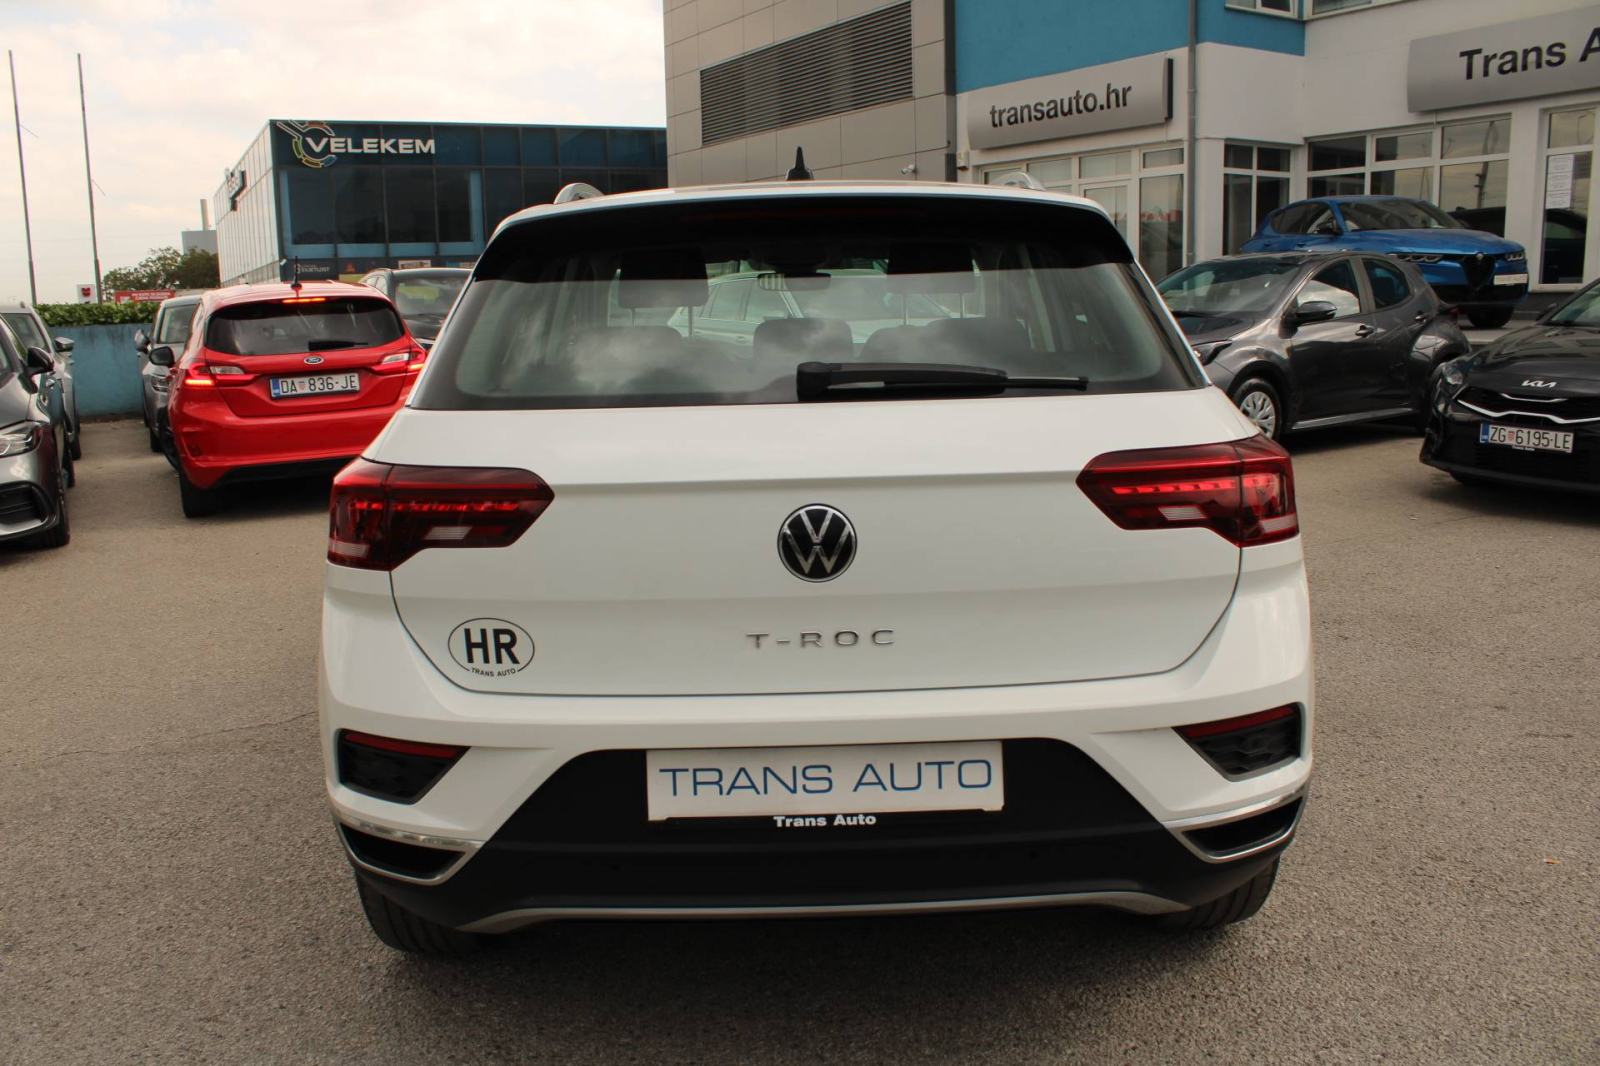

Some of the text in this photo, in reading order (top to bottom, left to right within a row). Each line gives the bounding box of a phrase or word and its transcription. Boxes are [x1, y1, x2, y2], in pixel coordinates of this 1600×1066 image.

[1459, 41, 1567, 80] Trans
[989, 83, 1132, 128] transauto.hr
[306, 137, 436, 154] VELEKEM
[280, 380, 298, 394] DA
[1490, 427, 1506, 443] ZG
[464, 628, 520, 664] HR
[746, 630, 894, 648] T-ROC
[471, 667, 516, 677] TRANS AUTO
[659, 759, 992, 796] TRANS AUTO
[773, 813, 877, 828] Trans Auto
